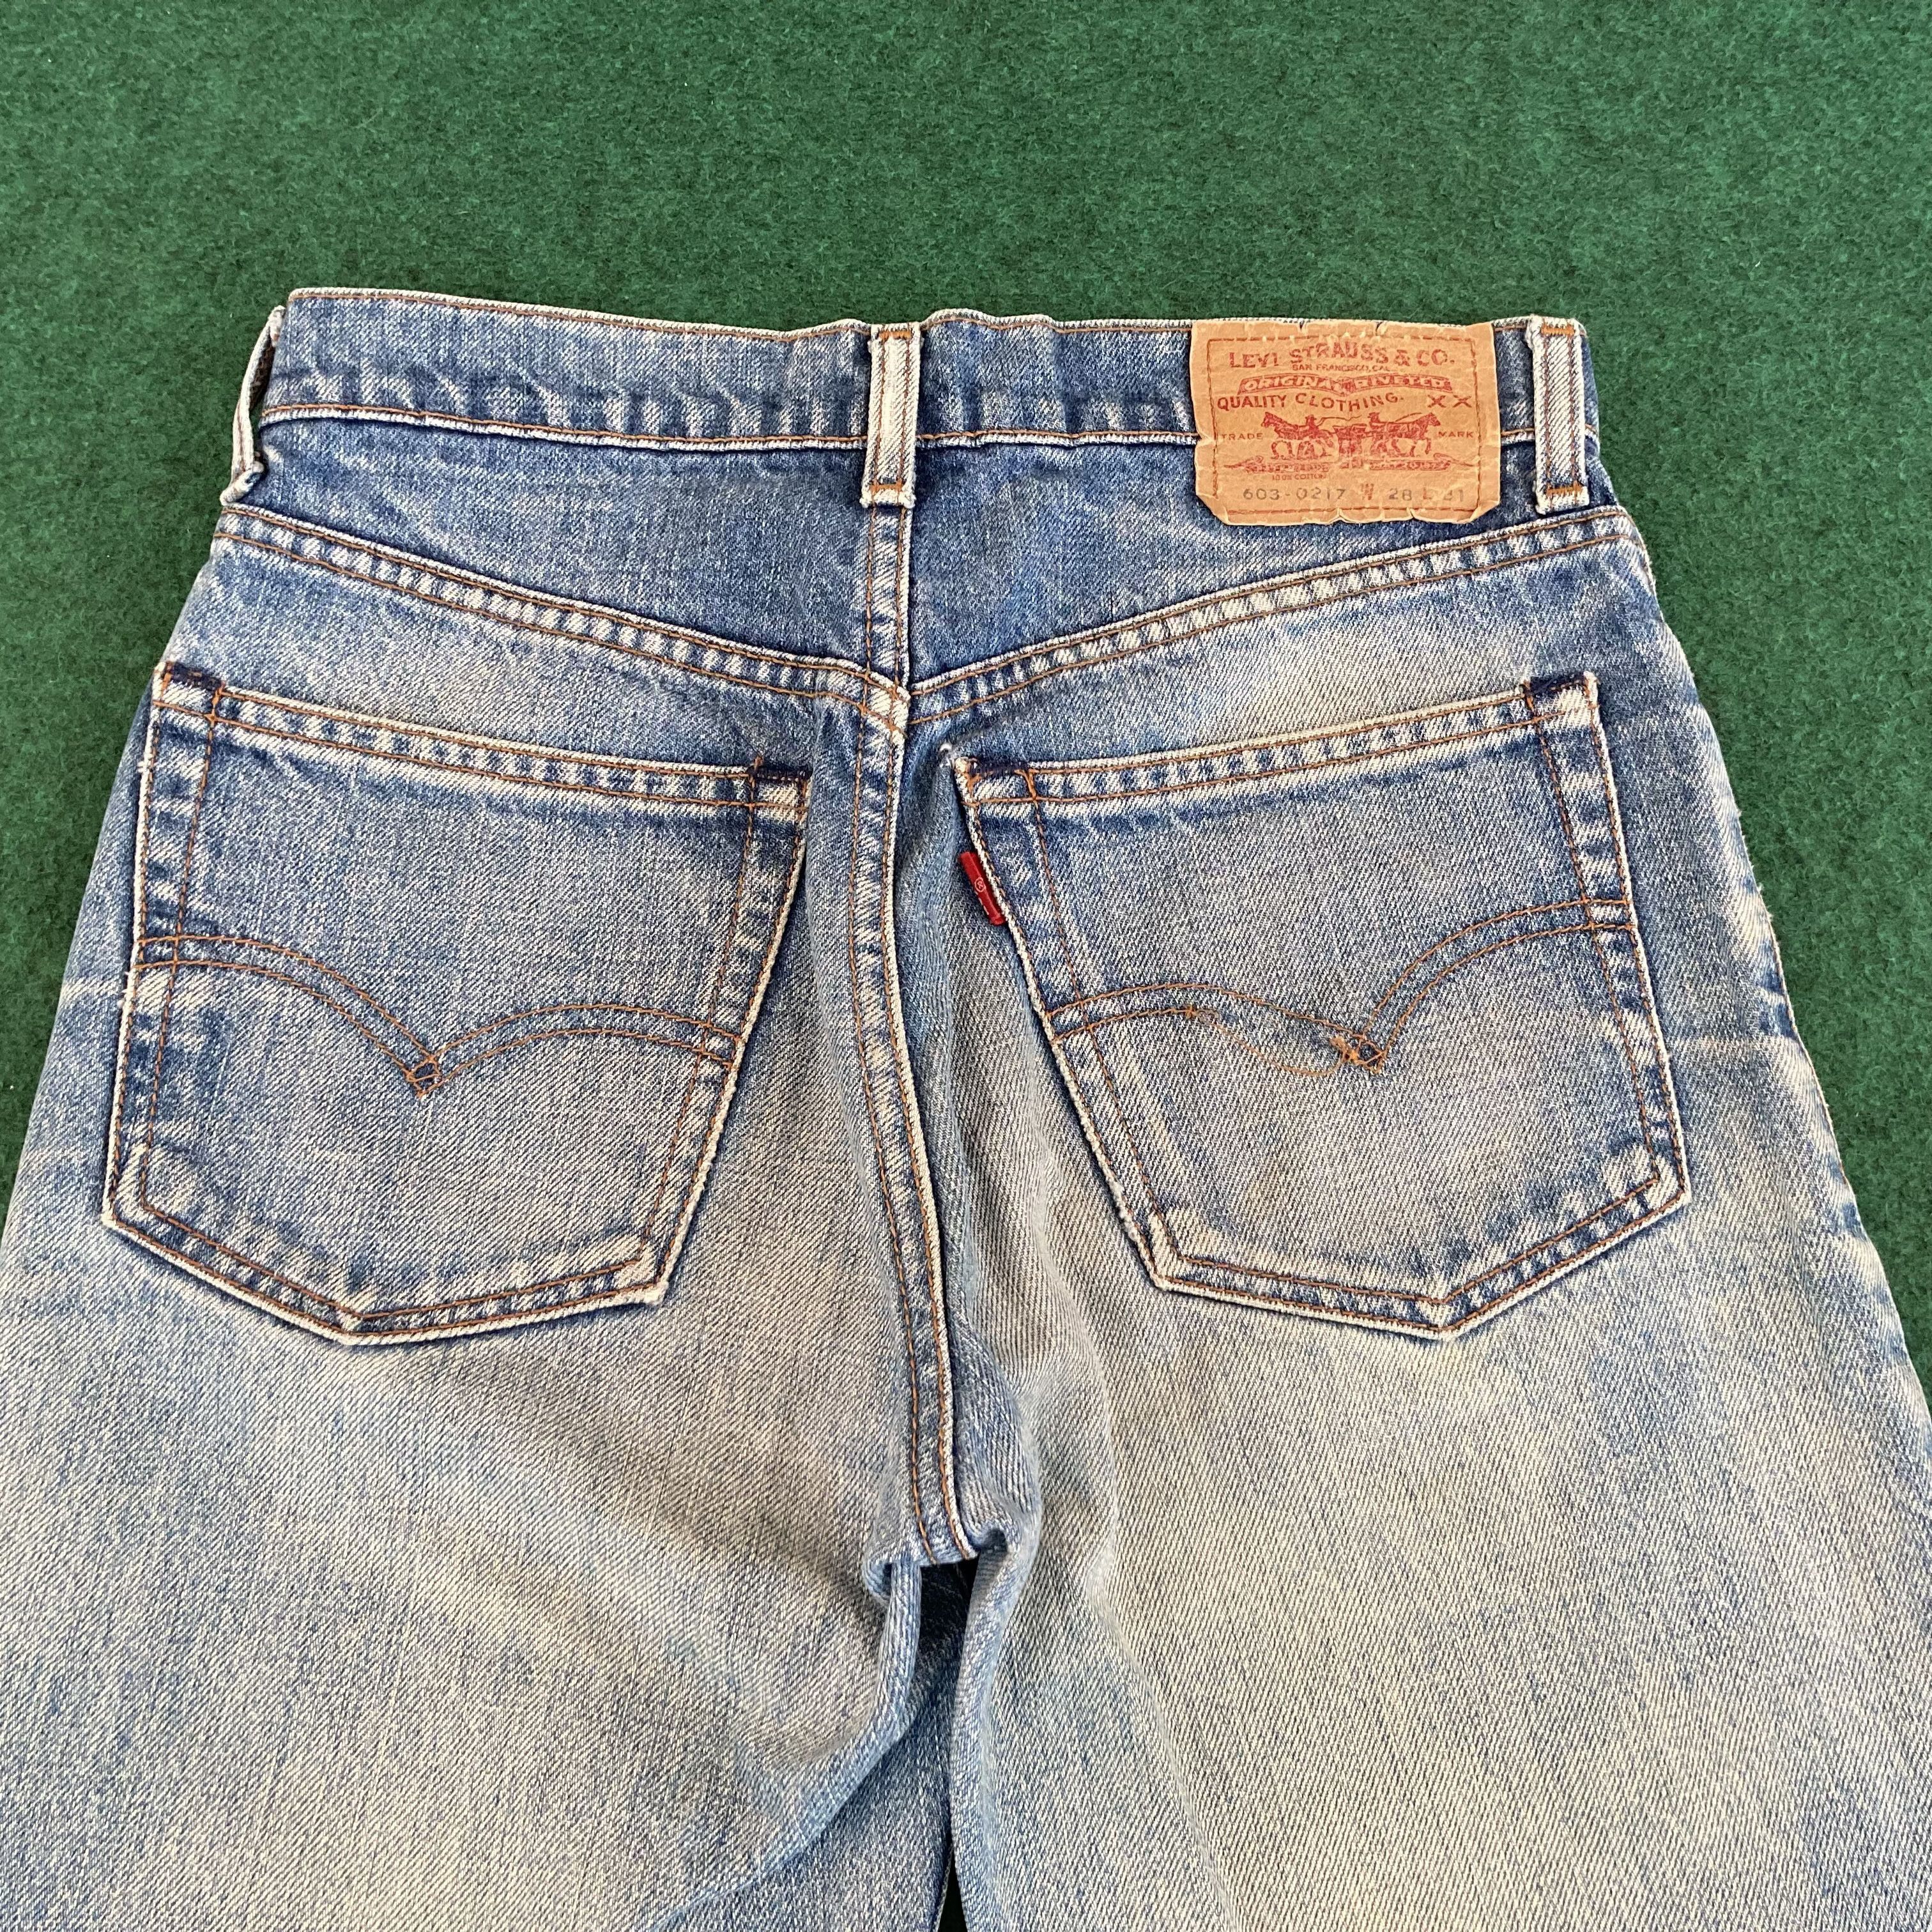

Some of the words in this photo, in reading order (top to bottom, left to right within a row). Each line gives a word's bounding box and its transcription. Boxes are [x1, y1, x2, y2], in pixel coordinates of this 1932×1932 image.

[1228, 352, 1278, 369] LEVI
[1289, 341, 1388, 365] STRAUSS
[1393, 349, 1411, 367] &
[1416, 349, 1455, 367] CO.
[1216, 394, 1287, 411] QUALITY
[1294, 392, 1404, 412] CLOTHING.
[1221, 433, 1263, 441] TRADE
[1243, 486, 1346, 501] 603-0217
[1388, 487, 1412, 502] 28
